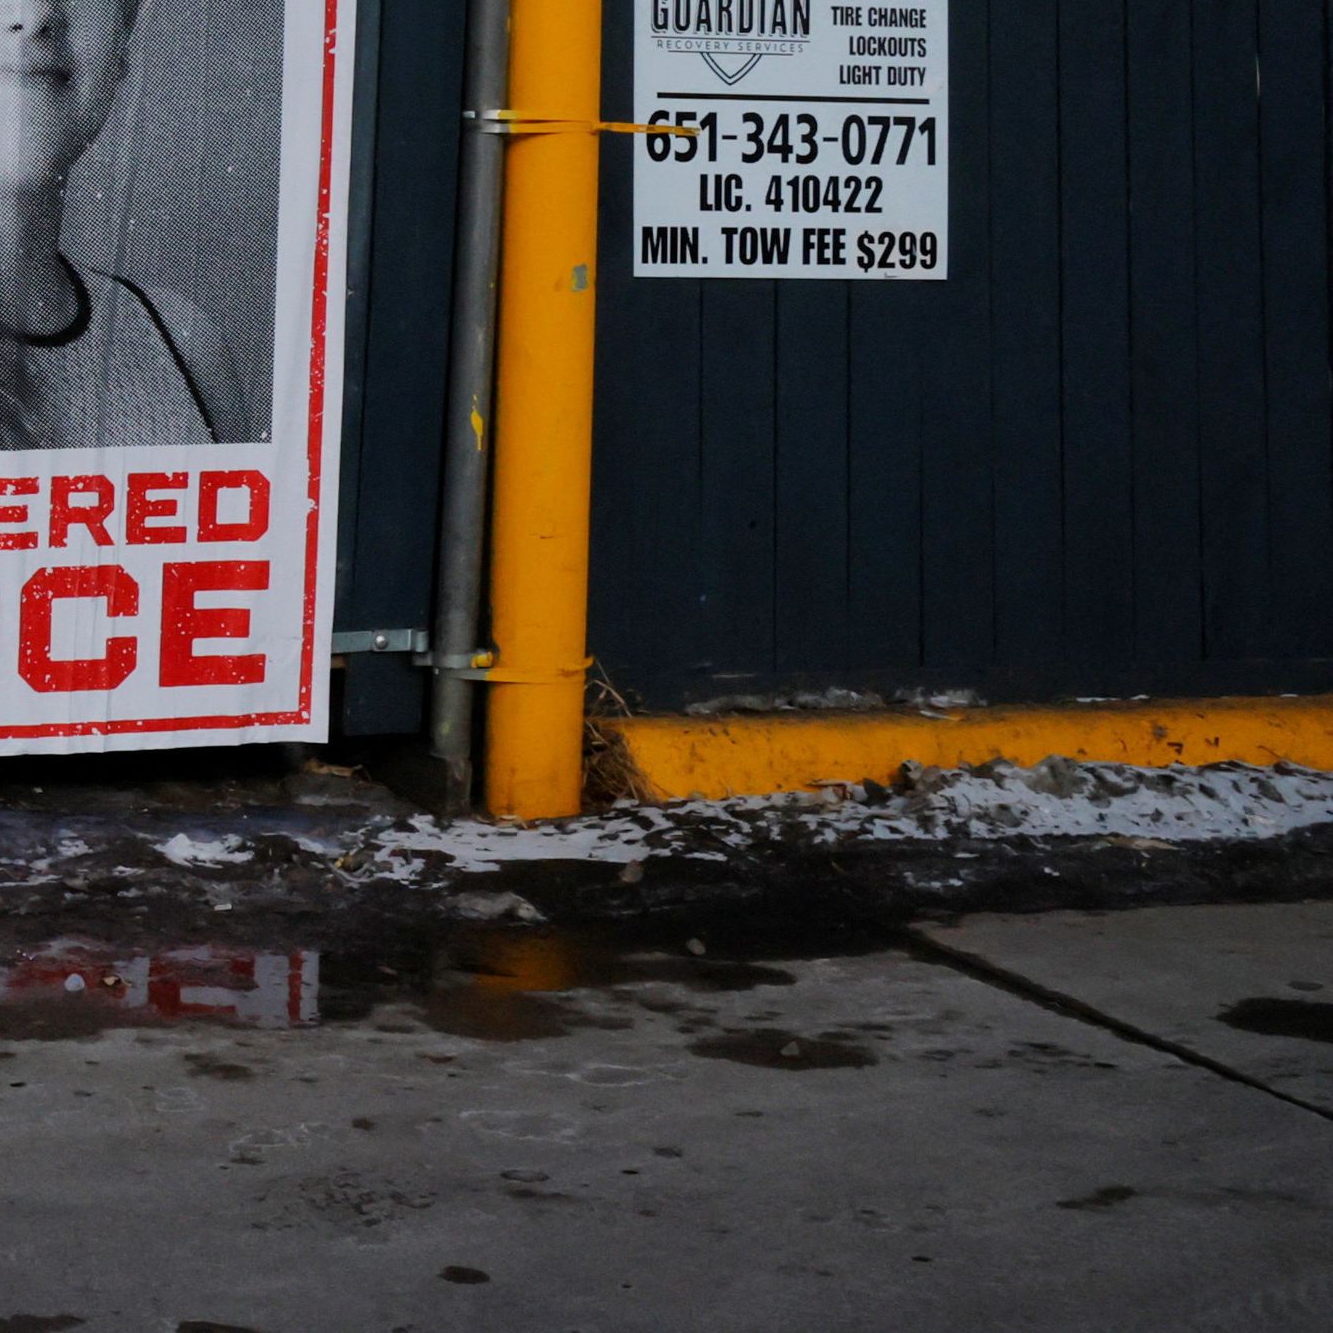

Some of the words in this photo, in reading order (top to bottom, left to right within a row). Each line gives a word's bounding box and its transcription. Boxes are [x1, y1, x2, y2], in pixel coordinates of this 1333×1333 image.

[831, 6, 862, 26] TIRE
[868, 7, 926, 28] CHANGE
[656, 39, 729, 51] RECOVERY
[737, 41, 804, 53] SERVICES
[849, 36, 926, 57] LOCKOUTS
[839, 65, 882, 86] LIGHT
[887, 67, 926, 87] DUTY
[646, 109, 936, 166] 651-343-0771
[699, 174, 752, 212] LIC.
[765, 175, 883, 213] 410422
[641, 226, 708, 265] MIN.
[721, 227, 791, 265] TOW
[802, 228, 846, 265] FEE
[856, 230, 938, 273] $299
